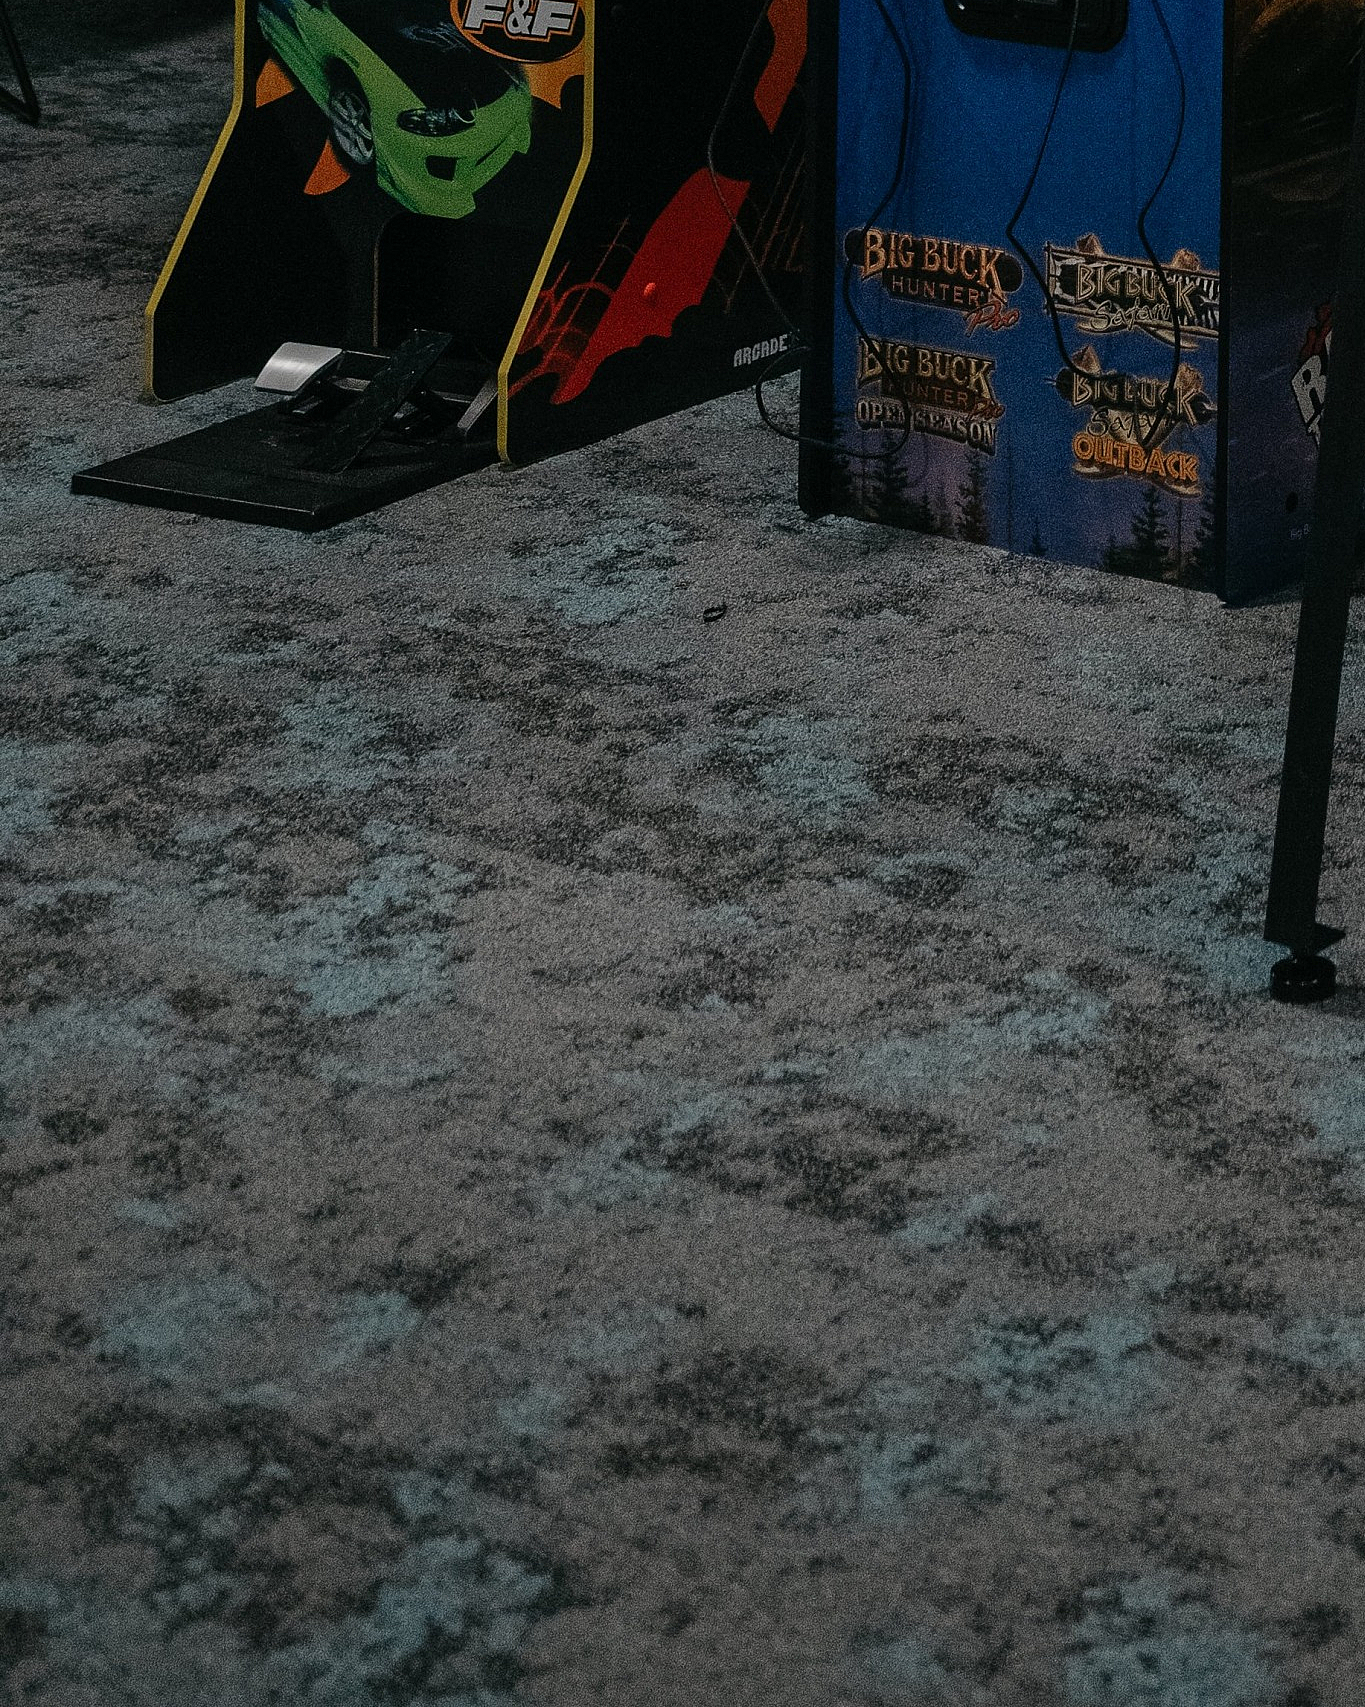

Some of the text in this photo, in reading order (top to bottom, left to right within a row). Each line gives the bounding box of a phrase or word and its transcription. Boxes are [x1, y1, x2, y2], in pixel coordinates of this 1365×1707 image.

[862, 228, 1006, 304] BIG BUCK
[1076, 262, 1120, 303] BIG
[892, 275, 980, 308] HUNTER
[966, 304, 1020, 337] Pro
[858, 338, 996, 403] BIG BUCK
[914, 405, 997, 456] SEASON
[1072, 433, 1198, 481] OUTBACK
